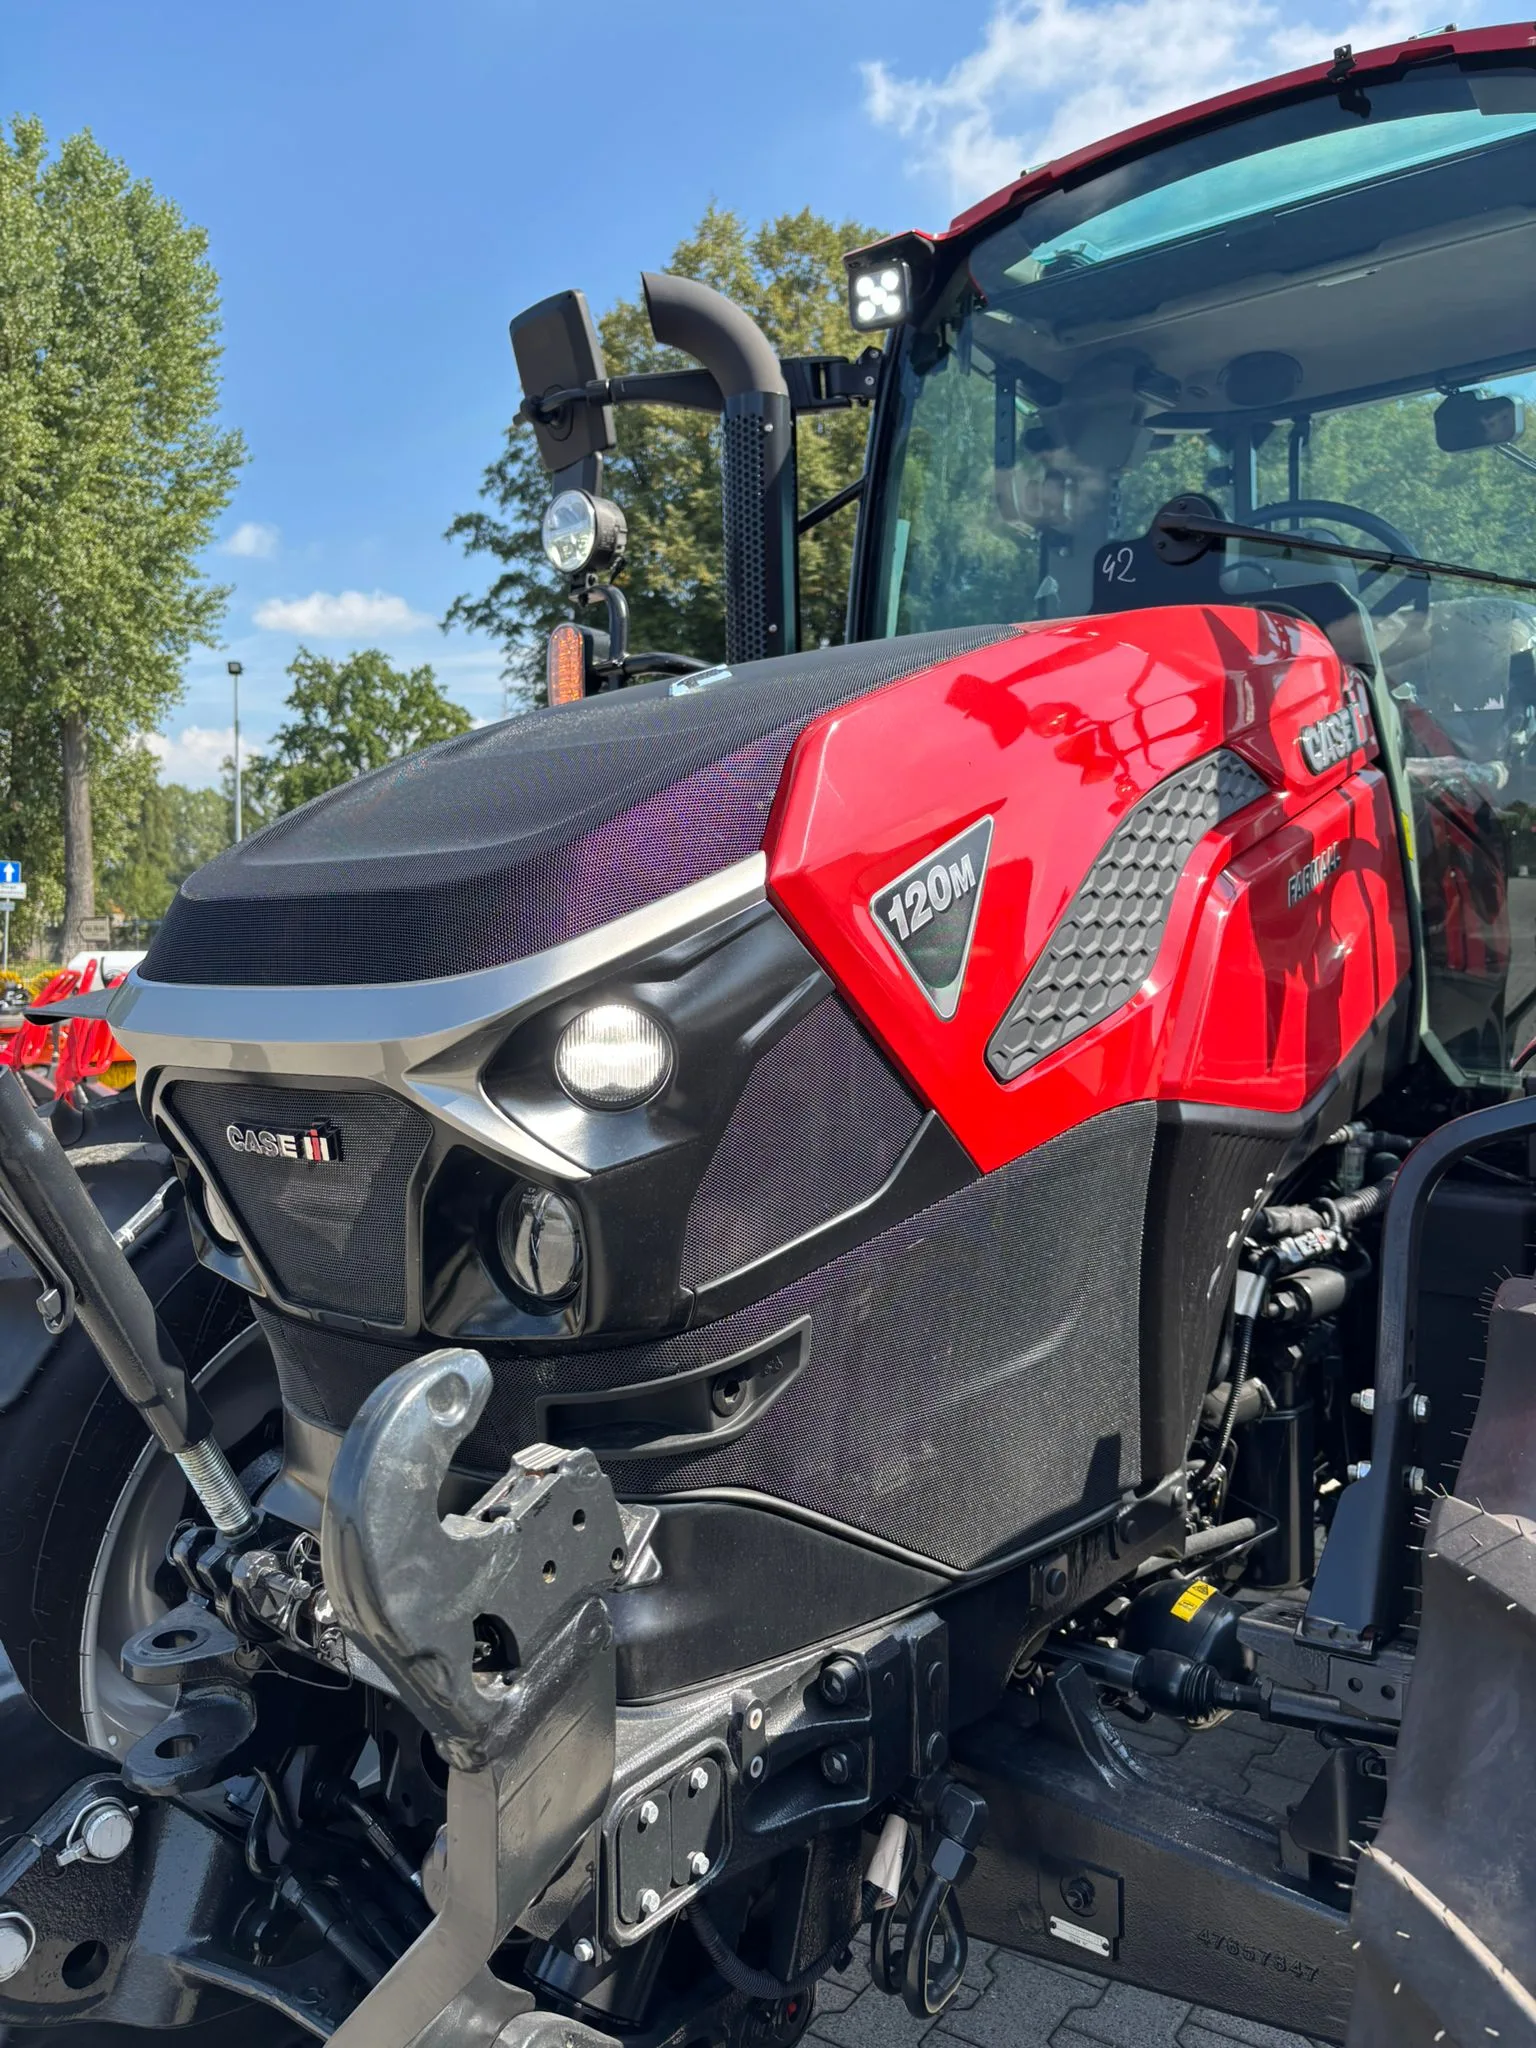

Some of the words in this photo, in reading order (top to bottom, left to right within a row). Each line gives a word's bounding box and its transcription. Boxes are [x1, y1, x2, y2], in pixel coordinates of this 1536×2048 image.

[1102, 547, 1136, 583] 42
[1301, 706, 1354, 775] CASE
[887, 852, 977, 941] 120M
[226, 1124, 298, 1159] CASE
